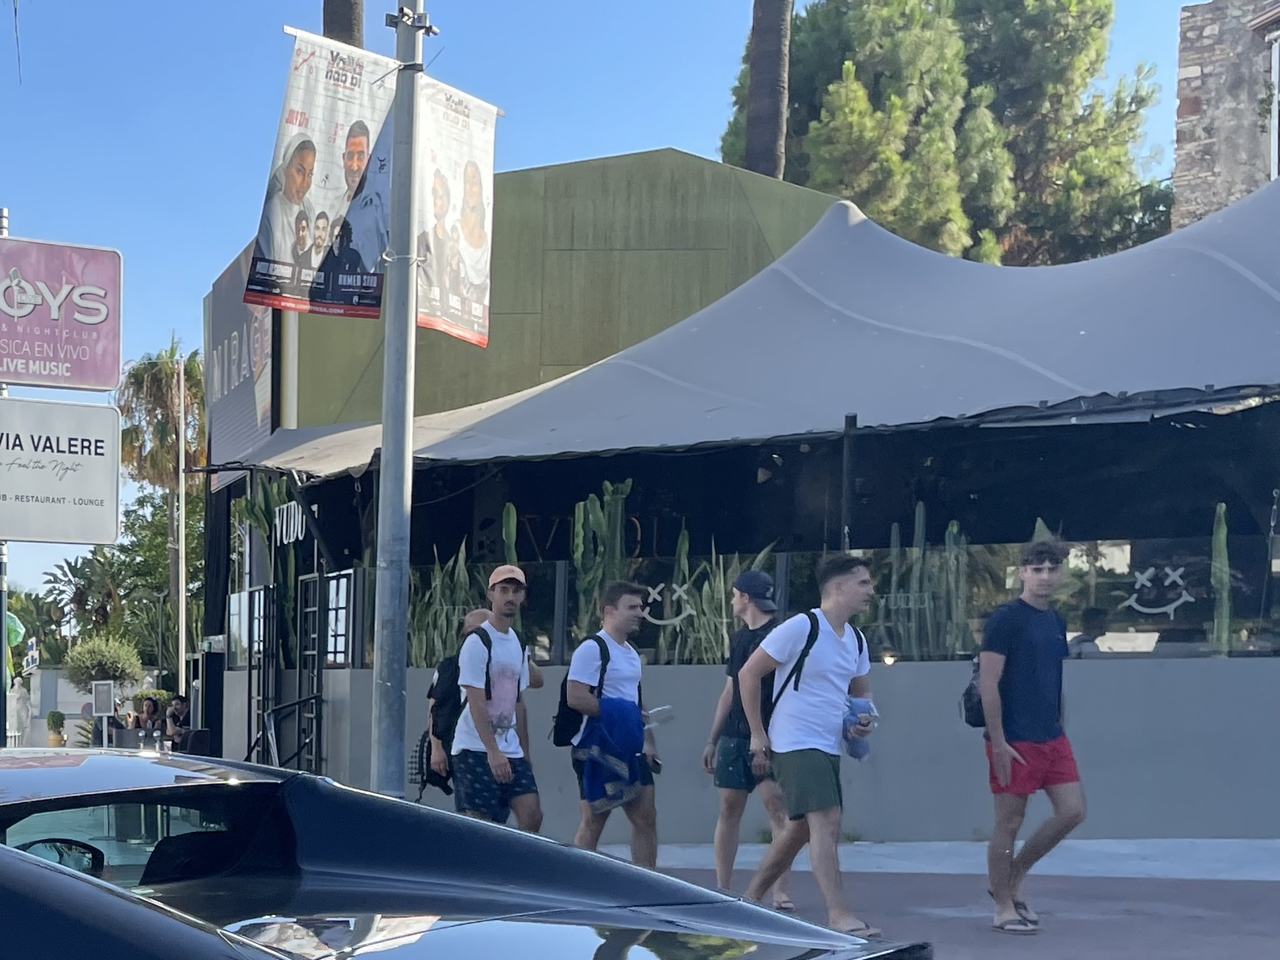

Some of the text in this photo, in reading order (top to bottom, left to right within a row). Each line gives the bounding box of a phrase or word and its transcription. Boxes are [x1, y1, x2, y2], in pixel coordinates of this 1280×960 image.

[35, 341, 53, 358] EN
[57, 343, 90, 361] VIVO
[29, 359, 72, 377] MUSIC
[30, 434, 105, 456] VALERE
[30, 459, 47, 470] the
[48, 459, 84, 481] Night
[14, 494, 66, 504] RESTAURANT
[73, 497, 105, 507] LOUNGE
